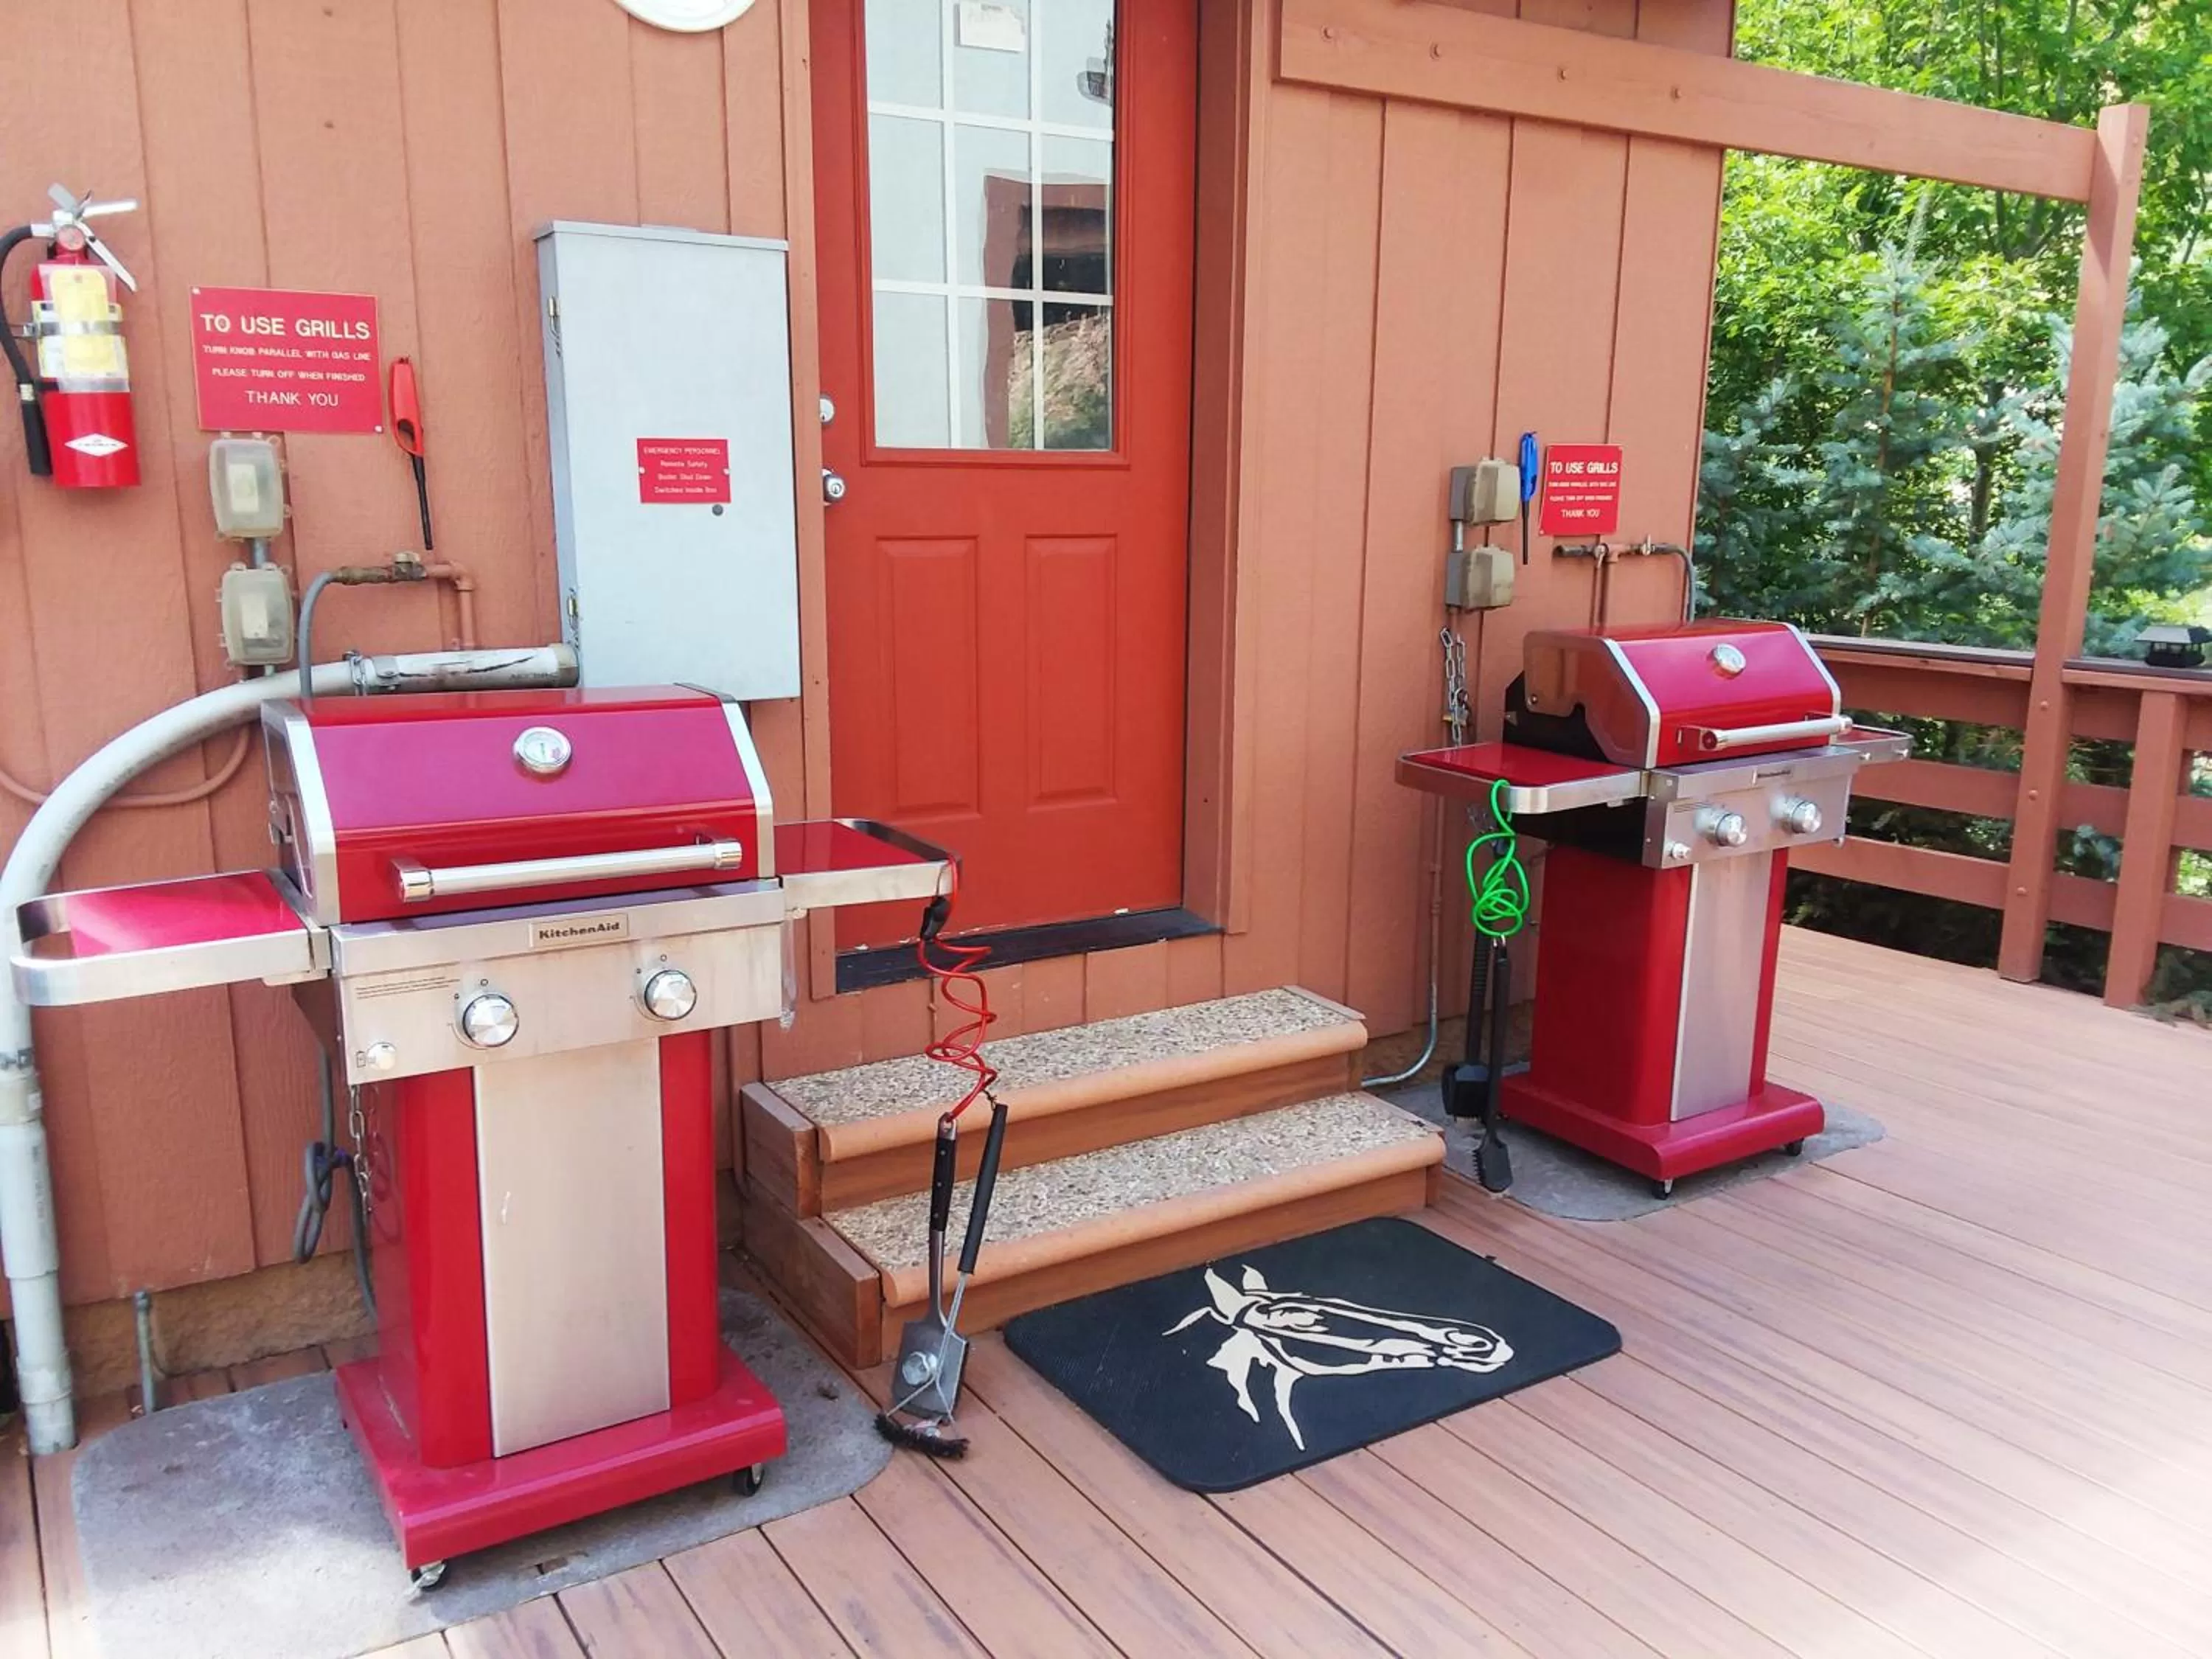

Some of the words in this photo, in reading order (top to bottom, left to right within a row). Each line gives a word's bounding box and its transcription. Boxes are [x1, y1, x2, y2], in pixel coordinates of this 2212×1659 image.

[201, 313, 231, 333] TO
[241, 316, 286, 335] USE
[296, 319, 370, 340] GRILLS
[202, 345, 227, 354] TURN
[229, 346, 255, 356] KNOB
[258, 347, 302, 358] PARALLEL
[305, 350, 329, 360] WITH
[332, 352, 350, 361] GAS
[353, 352, 371, 361] LINE
[212, 368, 247, 378] PLEASE
[251, 369, 274, 378] TURN
[277, 369, 295, 378] OFF
[298, 370, 324, 380] WHEN
[326, 371, 365, 381] FINISHED
[245, 390, 301, 406] THANK
[307, 392, 339, 406] YOU
[1550, 462, 1562, 473] TO
[1565, 462, 1585, 473] USE
[1587, 462, 1618, 473] GRILLS
[1561, 509, 1585, 518] THANK
[1586, 509, 1601, 518] YOU
[539, 922, 620, 939] KitchenAid
